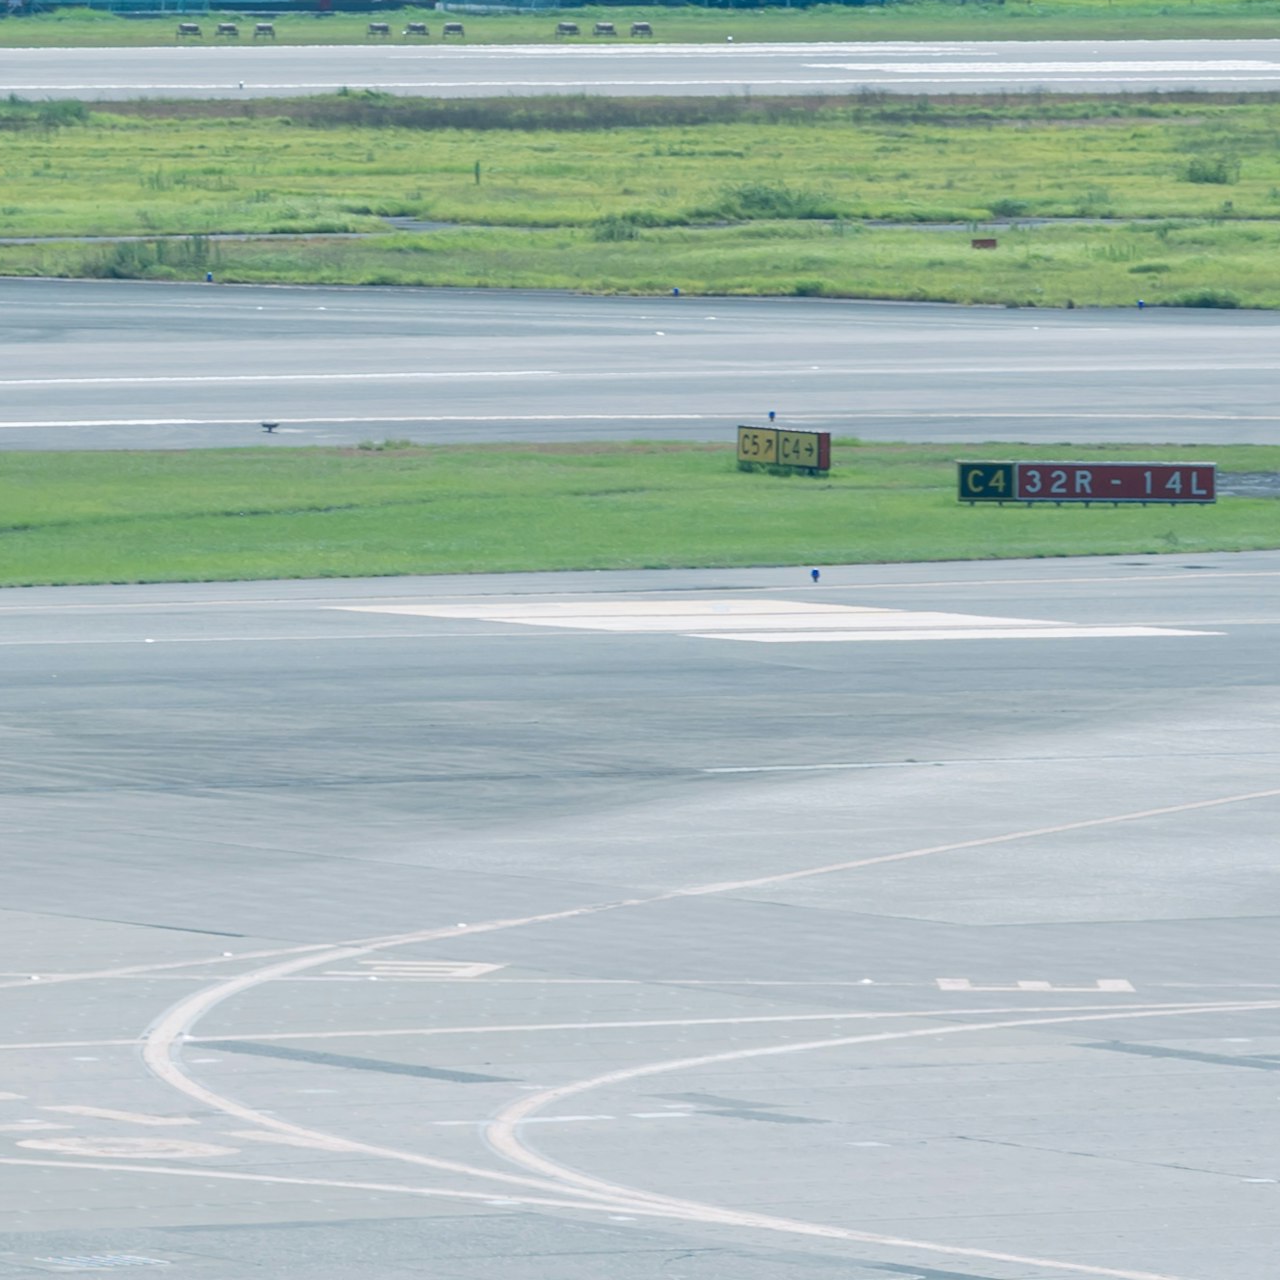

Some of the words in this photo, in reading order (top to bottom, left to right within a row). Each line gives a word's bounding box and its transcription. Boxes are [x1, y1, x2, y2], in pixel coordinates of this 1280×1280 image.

[742, 434, 760, 456] C5
[782, 437, 801, 460] C4
[967, 469, 1006, 493] C4
[1025, 469, 1093, 494] 32R
[1143, 470, 1208, 495] 14L
